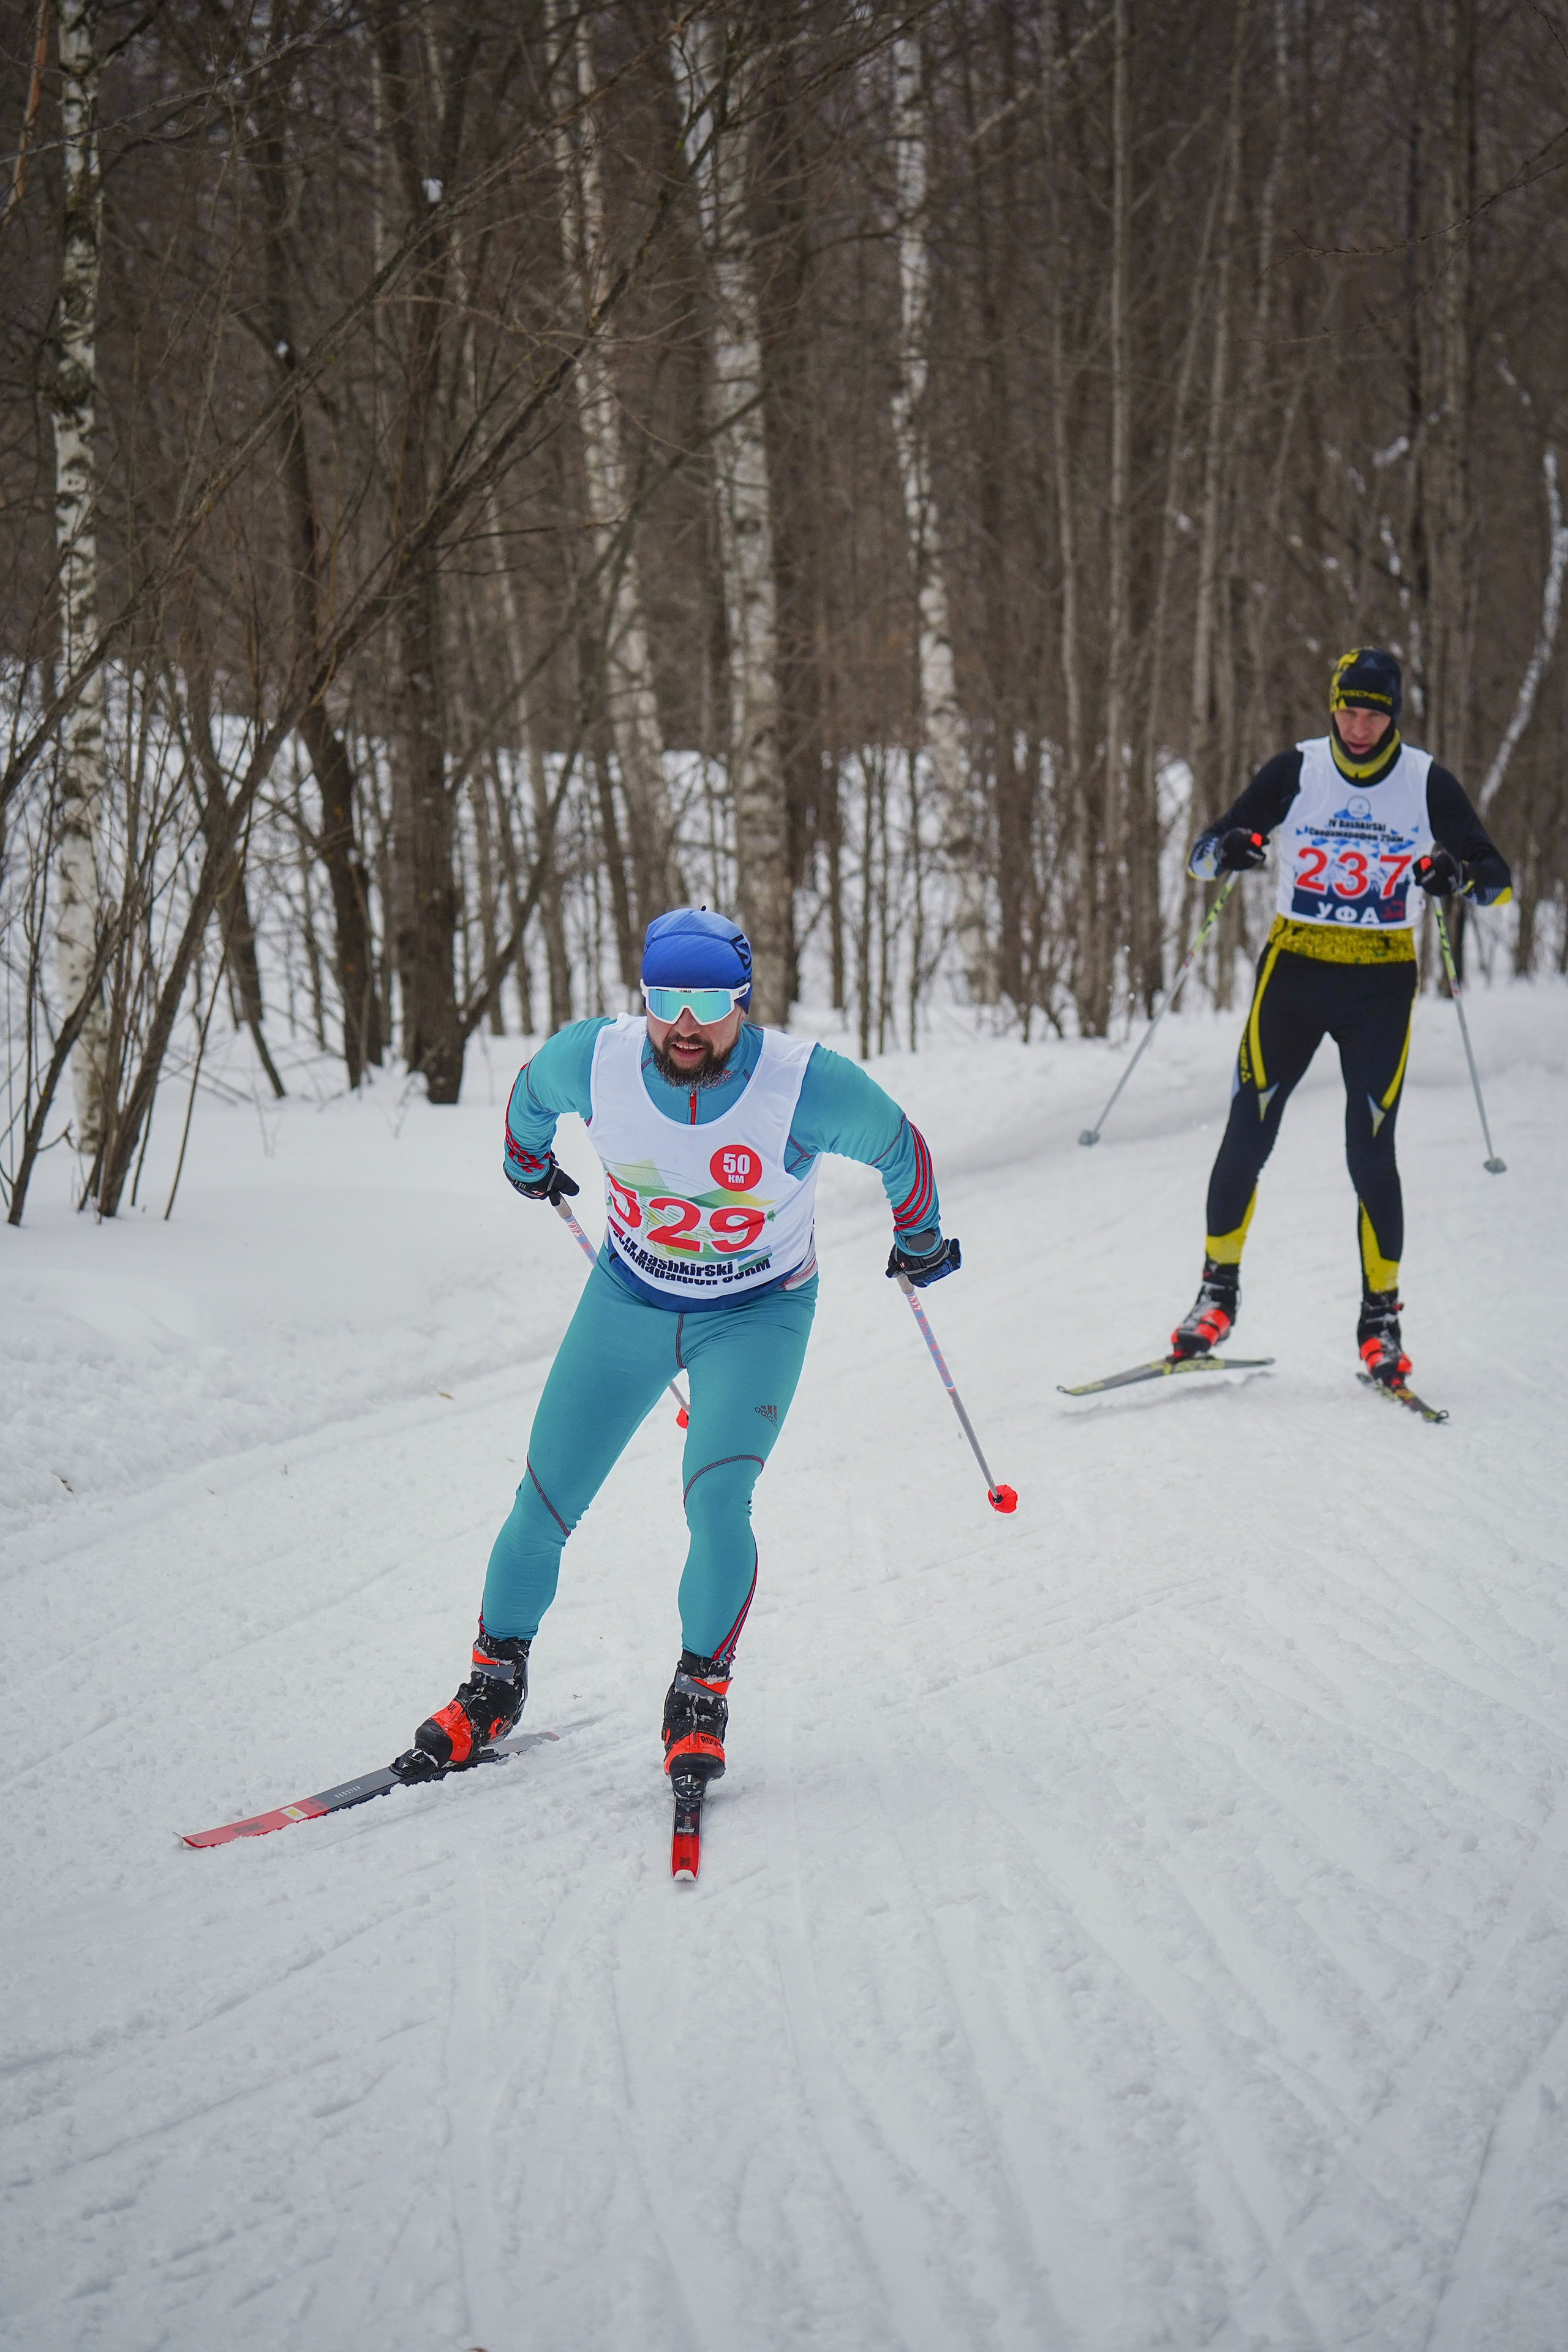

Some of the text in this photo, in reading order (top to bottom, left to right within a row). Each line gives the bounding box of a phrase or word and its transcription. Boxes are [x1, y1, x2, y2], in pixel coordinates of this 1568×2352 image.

[1295, 846, 1413, 899] 237
[1316, 901, 1381, 924] УФА
[722, 1153, 751, 1175] 50
[334, 1785, 363, 1799] REDSTER
